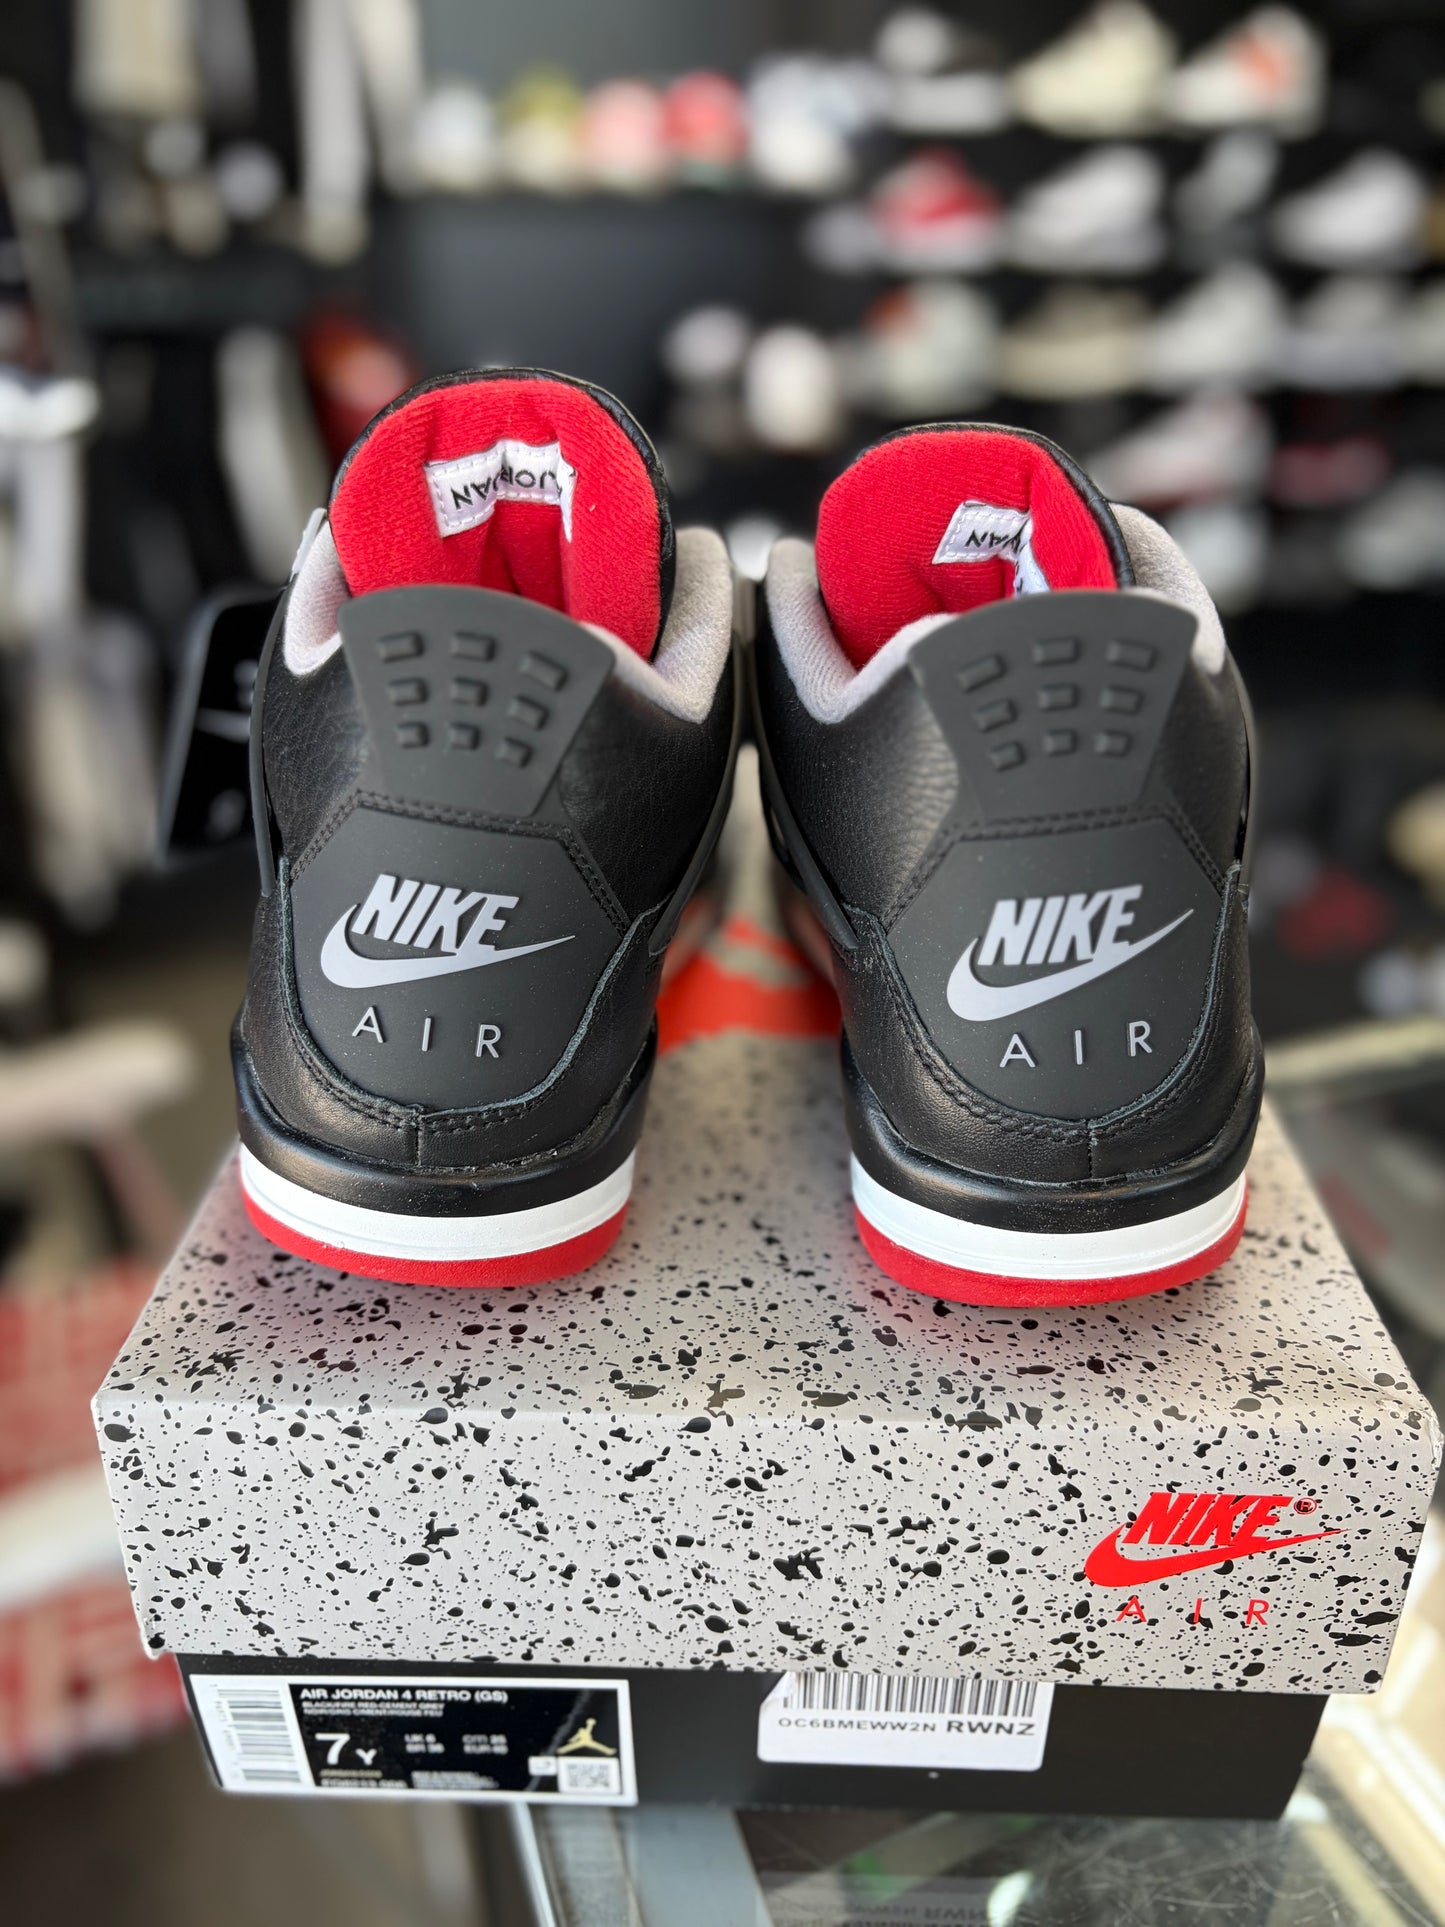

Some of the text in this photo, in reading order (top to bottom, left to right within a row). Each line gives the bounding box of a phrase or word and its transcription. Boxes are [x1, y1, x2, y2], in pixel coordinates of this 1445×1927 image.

[351, 873, 520, 957] NIKE
[977, 884, 1143, 965] NIKE
[352, 1006, 502, 1058] AIR
[999, 1020, 1153, 1068] AIR
[1121, 1491, 1295, 1547] NIKE
[1116, 1595, 1270, 1626] AIR
[300, 1688, 508, 1704] AIR JORDAN 4 RETRO (GS)
[946, 1720, 1036, 1736] RWNZ
